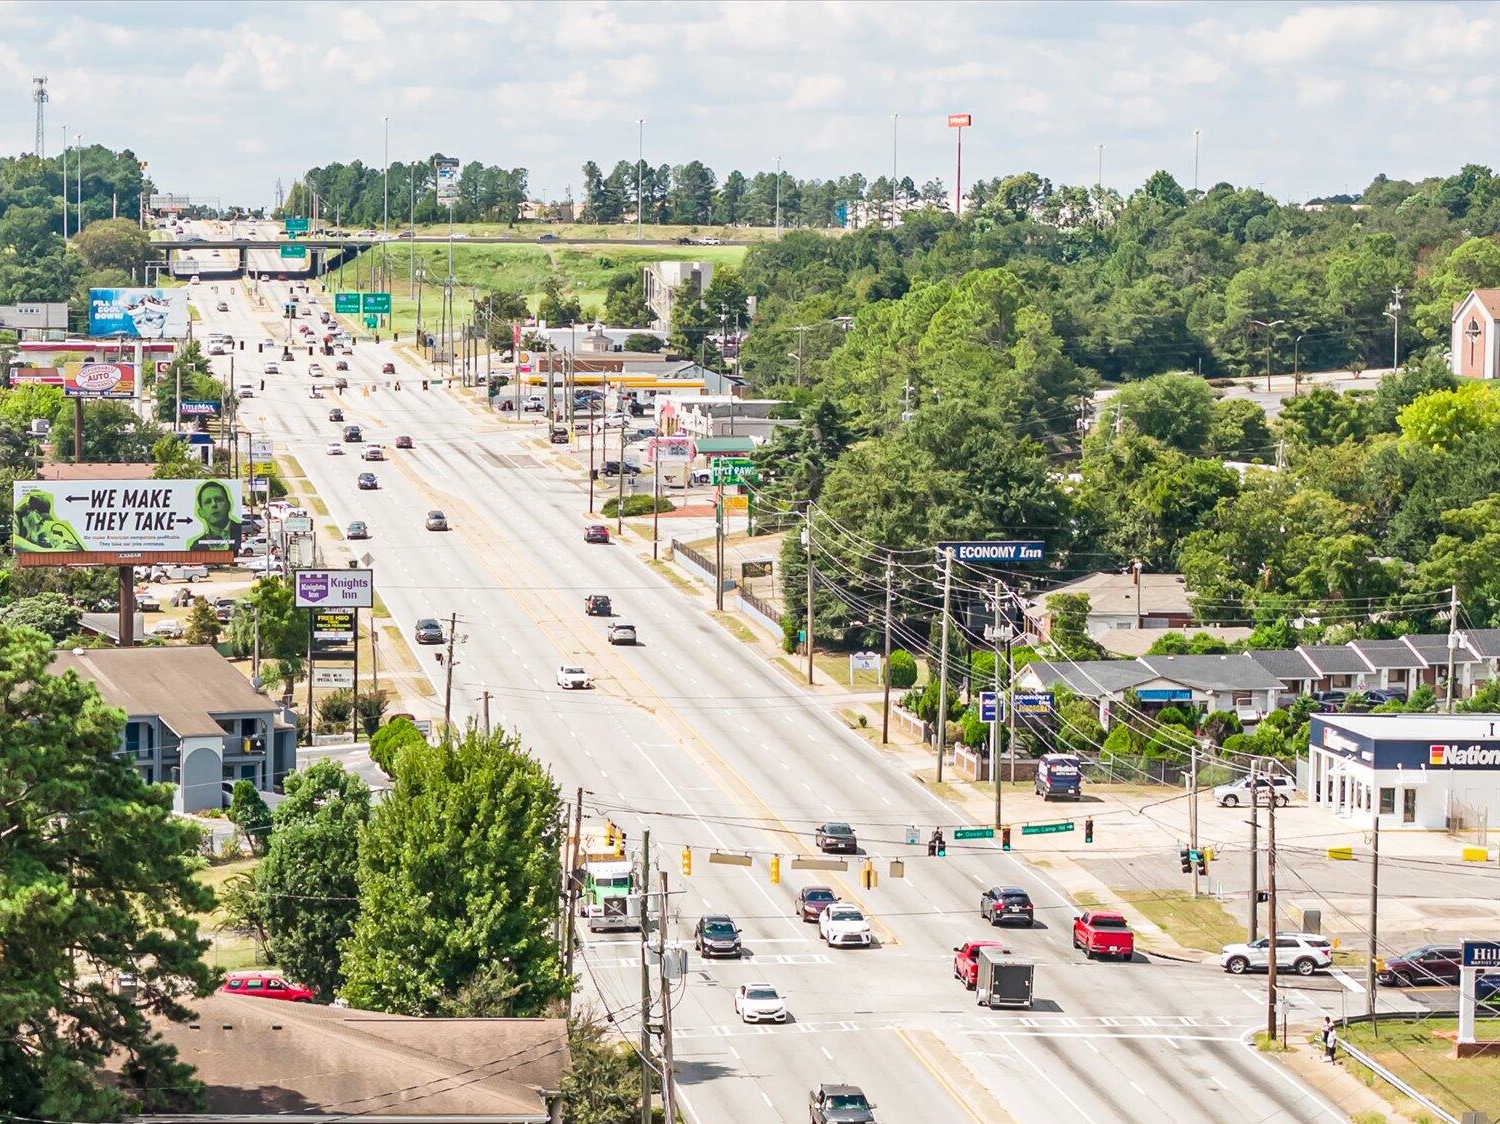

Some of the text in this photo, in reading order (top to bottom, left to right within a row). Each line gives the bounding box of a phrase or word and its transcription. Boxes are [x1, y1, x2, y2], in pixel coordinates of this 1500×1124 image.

[87, 372, 110, 381] AUTO
[91, 489, 173, 508] WE MAKE
[85, 512, 176, 531] THEY TAKE
[960, 546, 1042, 559] ECONOMY Inn
[301, 583, 326, 591] Knights
[331, 577, 369, 590] Knights
[342, 590, 358, 599] Inn
